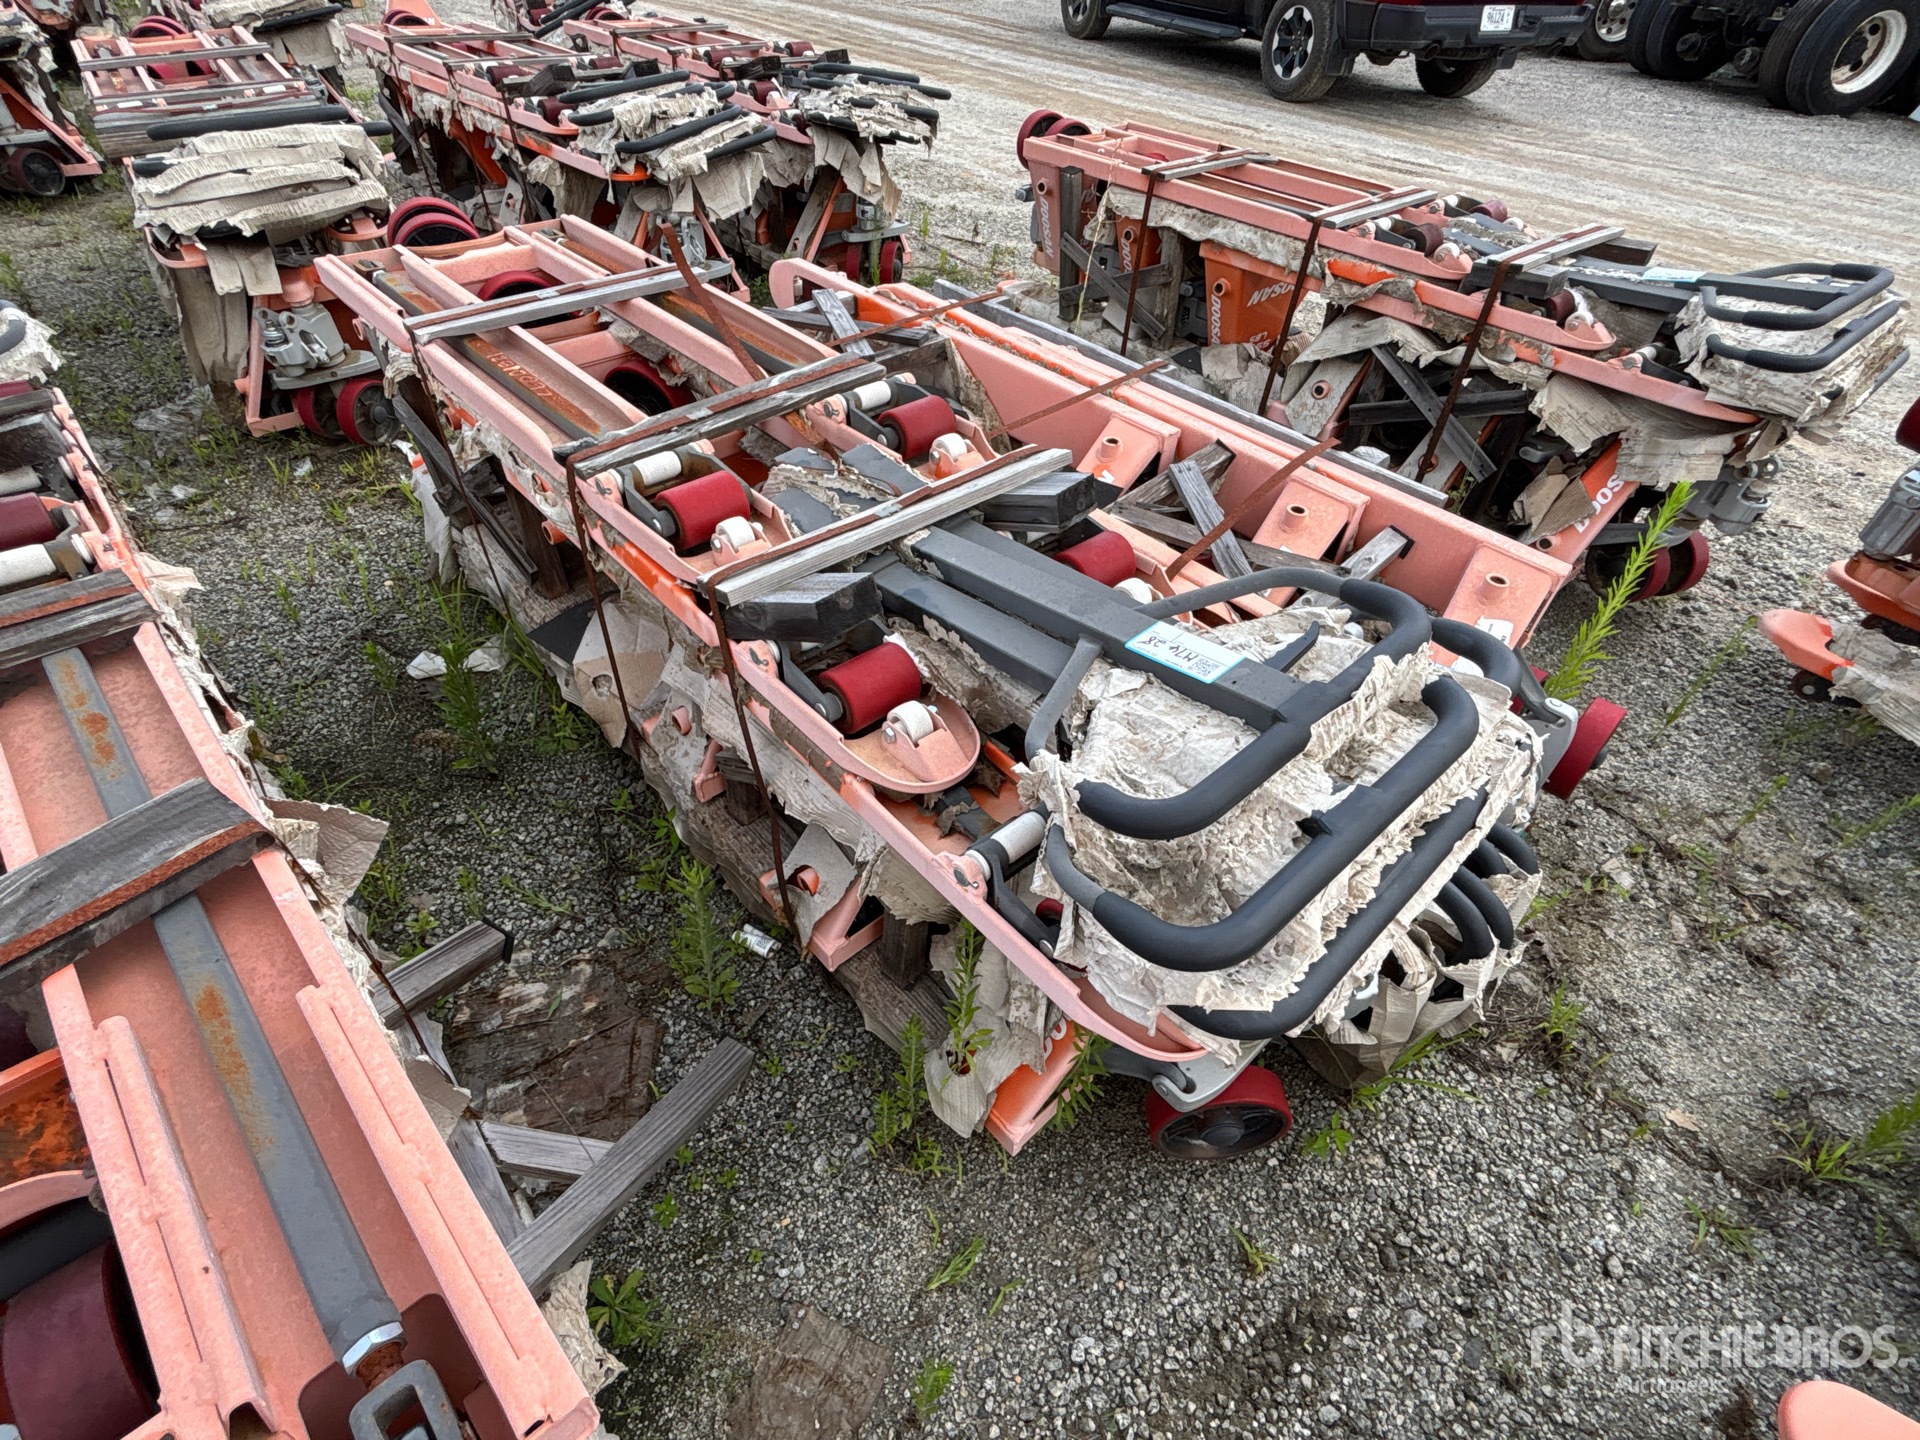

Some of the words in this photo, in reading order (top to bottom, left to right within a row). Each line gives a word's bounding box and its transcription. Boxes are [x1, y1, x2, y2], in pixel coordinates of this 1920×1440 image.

[1039, 195, 1054, 259] DOOSAN
[1120, 238, 1132, 272] DOO
[1246, 281, 1296, 307] OSAN
[1210, 294, 1222, 345] DOOSA
